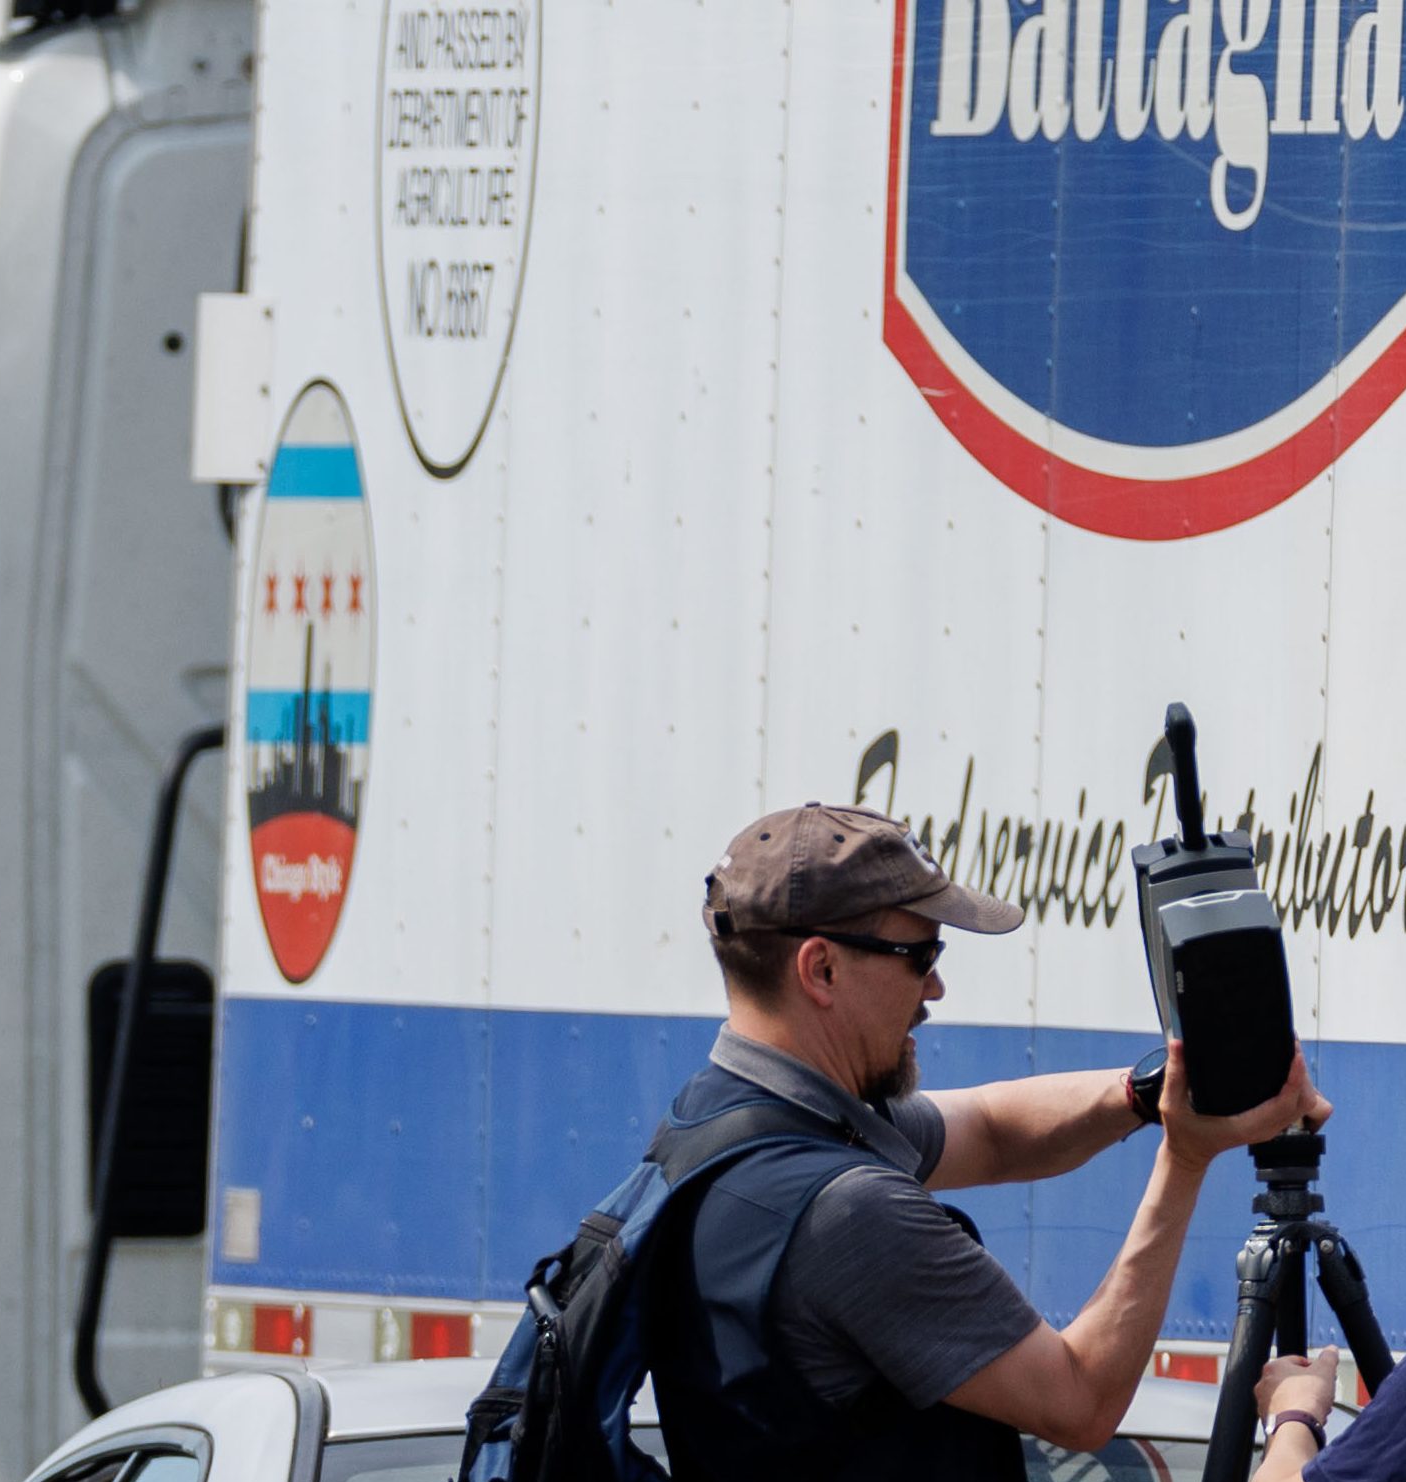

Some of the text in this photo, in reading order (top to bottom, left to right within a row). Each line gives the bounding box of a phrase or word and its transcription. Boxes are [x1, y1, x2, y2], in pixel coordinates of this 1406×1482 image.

[435, 10, 501, 69] PASSED
[505, 10, 530, 69] BY
[388, 87, 529, 148] DEPARTMENT OF
[395, 167, 514, 226] AGRICULTURE
